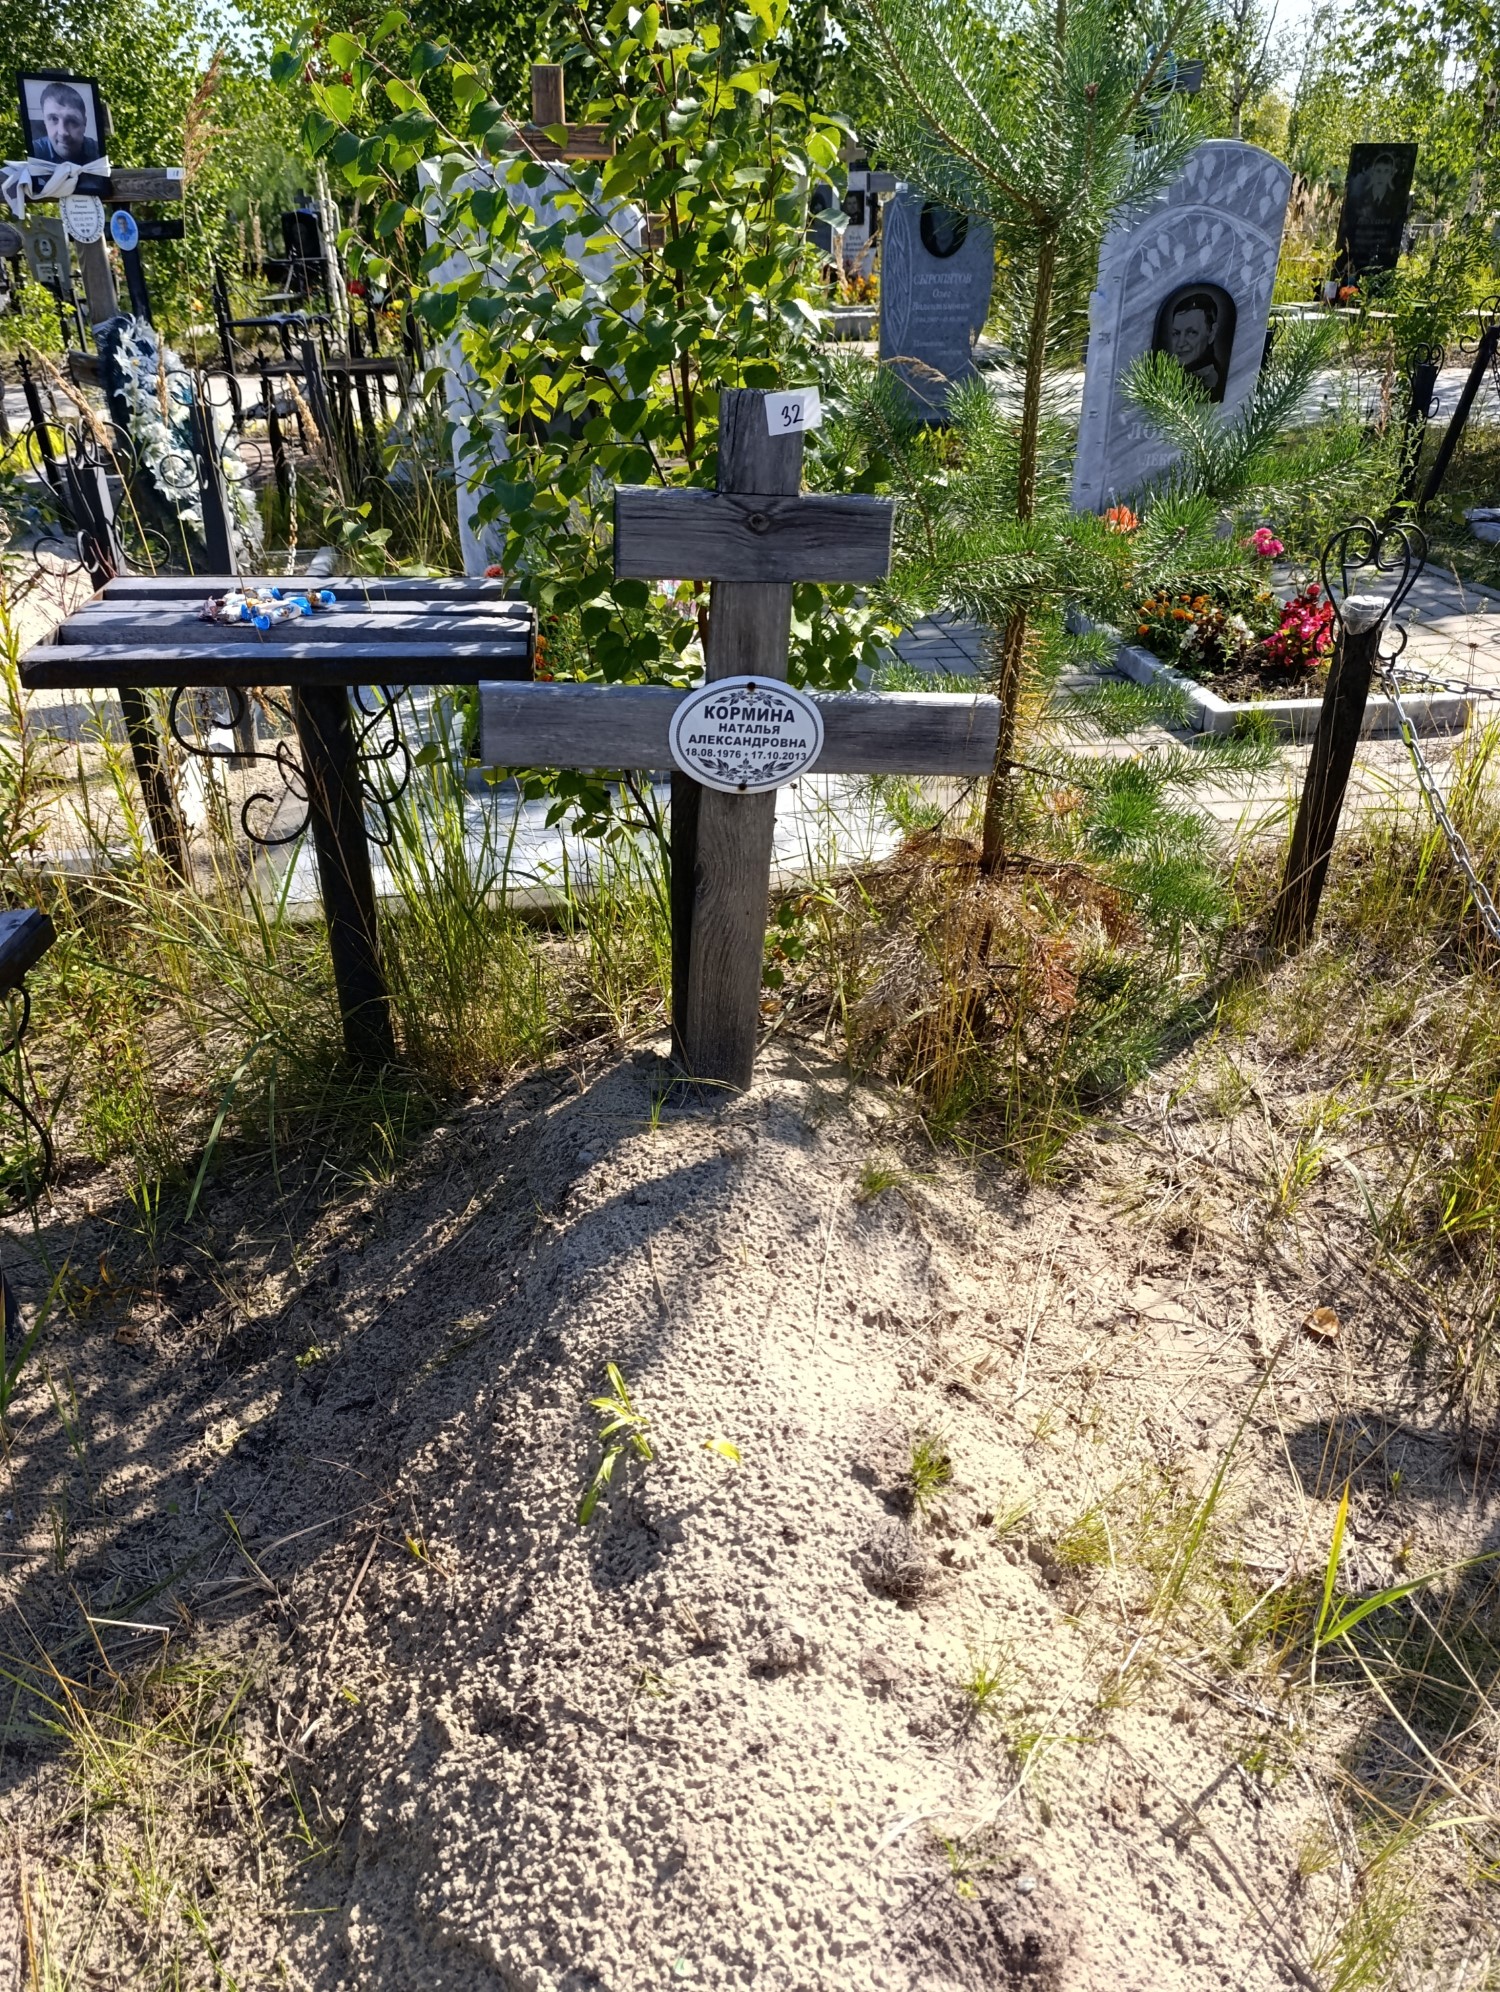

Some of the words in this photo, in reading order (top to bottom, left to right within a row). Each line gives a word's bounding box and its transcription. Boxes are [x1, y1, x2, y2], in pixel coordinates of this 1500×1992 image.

[781, 404, 804, 427] 32
[704, 705, 795, 723] КОРМИНА
[718, 723, 781, 735] НАТАЛЬЯ
[688, 734, 807, 748] АЛЕКСАНДРОВНА
[685, 747, 741, 759] 18.08.1976
[751, 751, 807, 761] 17.10.2013
